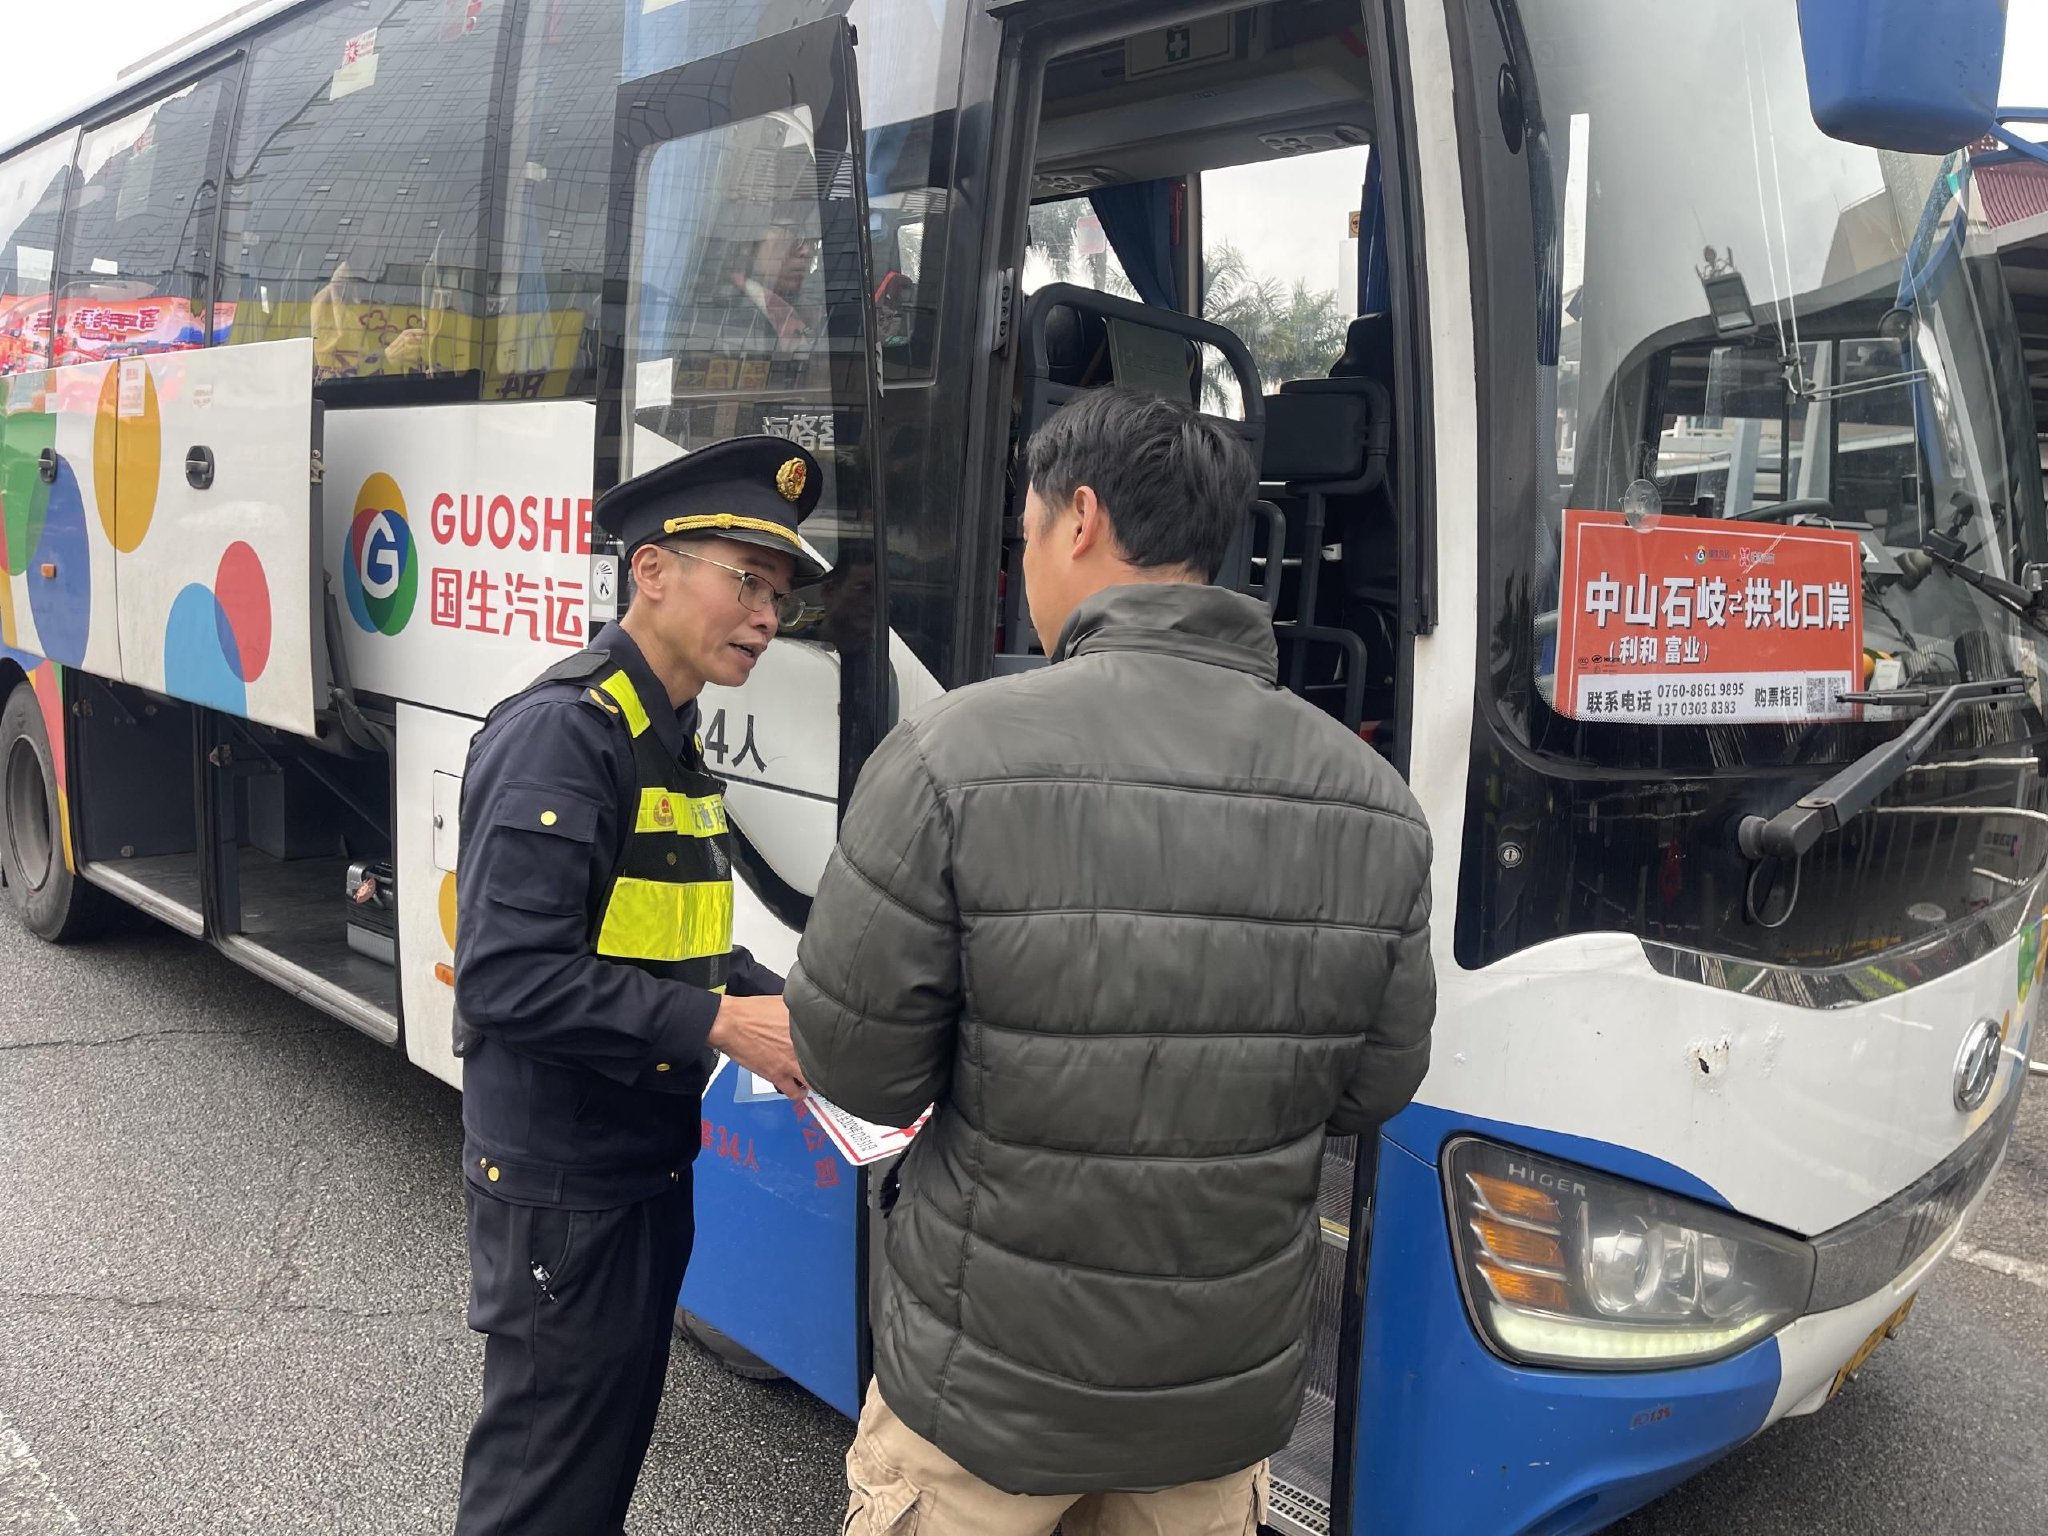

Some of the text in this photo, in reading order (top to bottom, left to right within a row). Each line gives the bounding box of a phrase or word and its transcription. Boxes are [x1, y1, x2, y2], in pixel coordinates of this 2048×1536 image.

[430, 492, 593, 555] GUOSHE
[430, 567, 584, 648] 国生汽运
[1585, 571, 1851, 630] 中山石岐 拱北口岸
[1586, 689, 1652, 714] 联系电话
[1657, 682, 1745, 699] 0760-8861 9895
[1754, 686, 1802, 708] 购票指引
[1656, 701, 1737, 717] 137 0303 8383
[697, 707, 768, 773] 4人
[1508, 1162, 1586, 1197] HIGER
